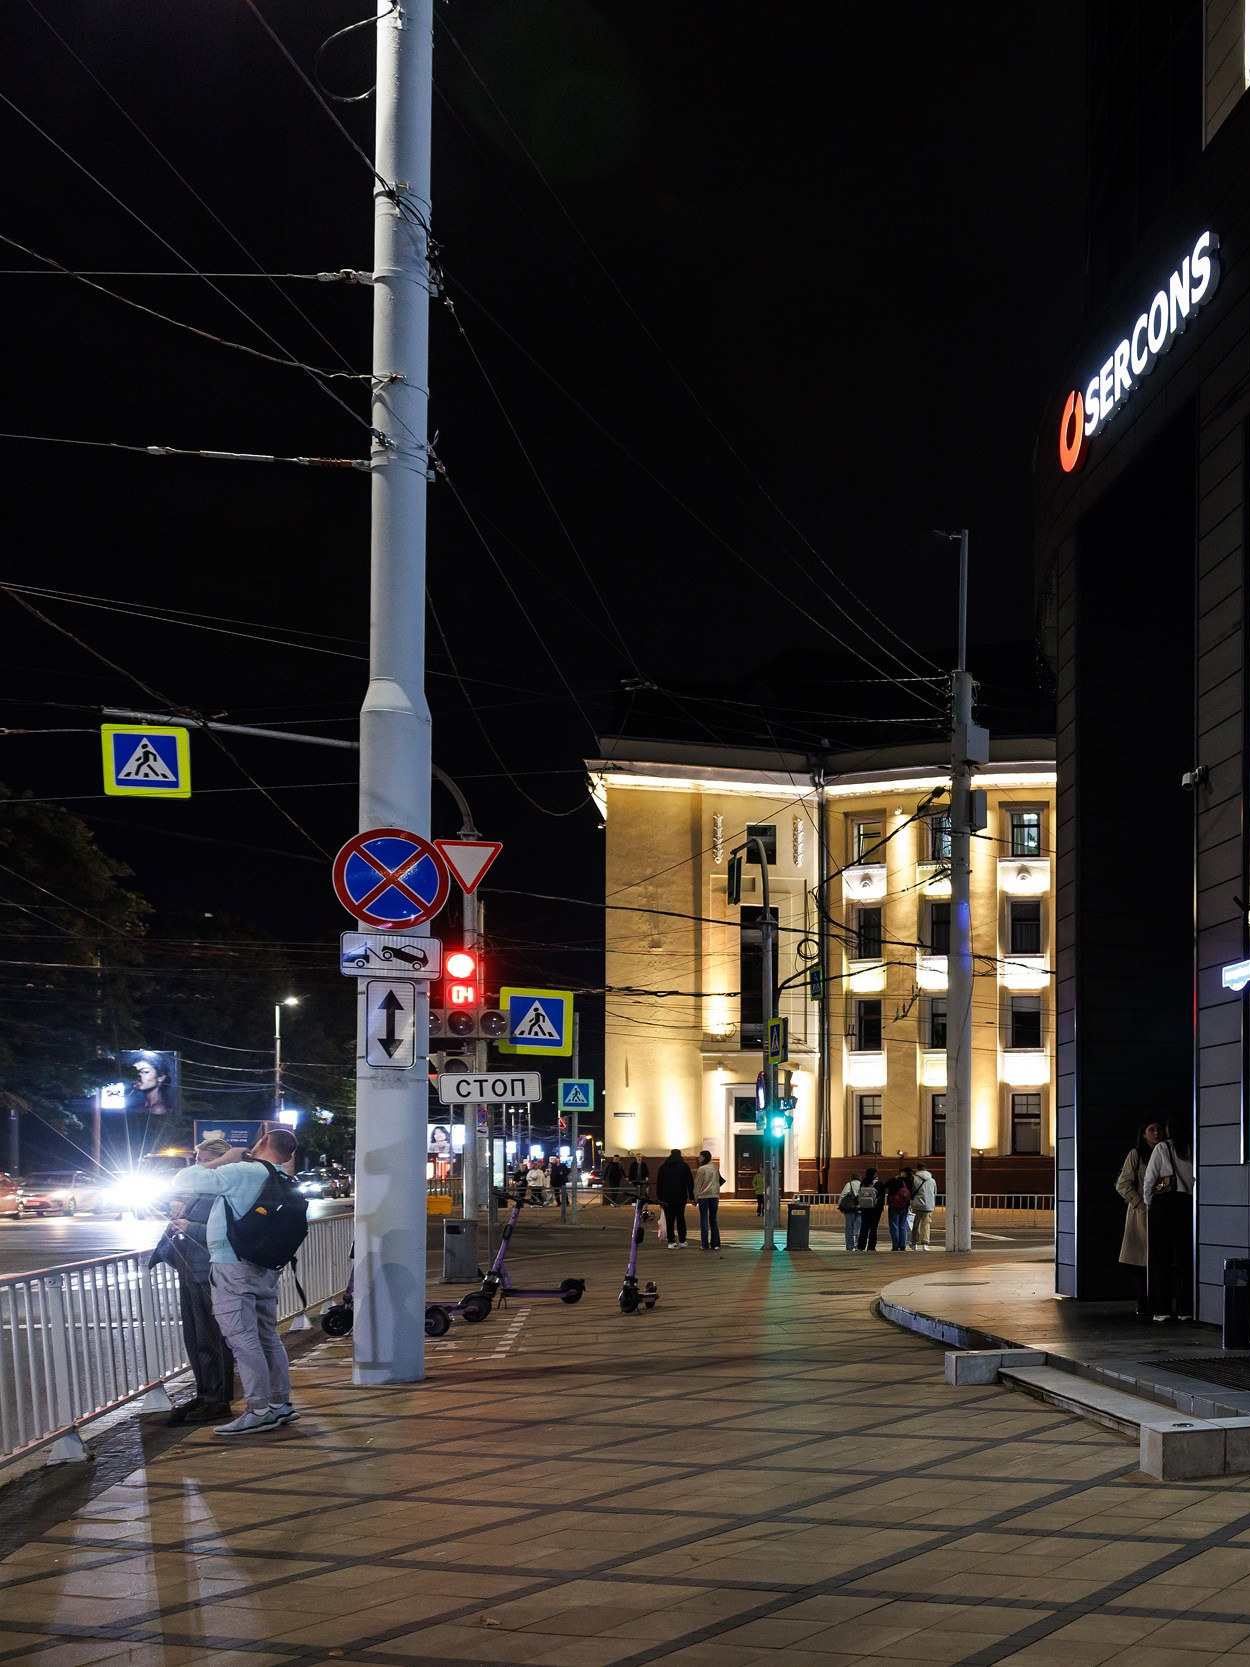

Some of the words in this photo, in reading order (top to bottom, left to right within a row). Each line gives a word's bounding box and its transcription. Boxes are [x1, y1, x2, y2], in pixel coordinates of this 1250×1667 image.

[1084, 231, 1213, 437] SERCONS
[451, 985, 474, 1004] 04
[455, 1078, 526, 1098] СТОП
